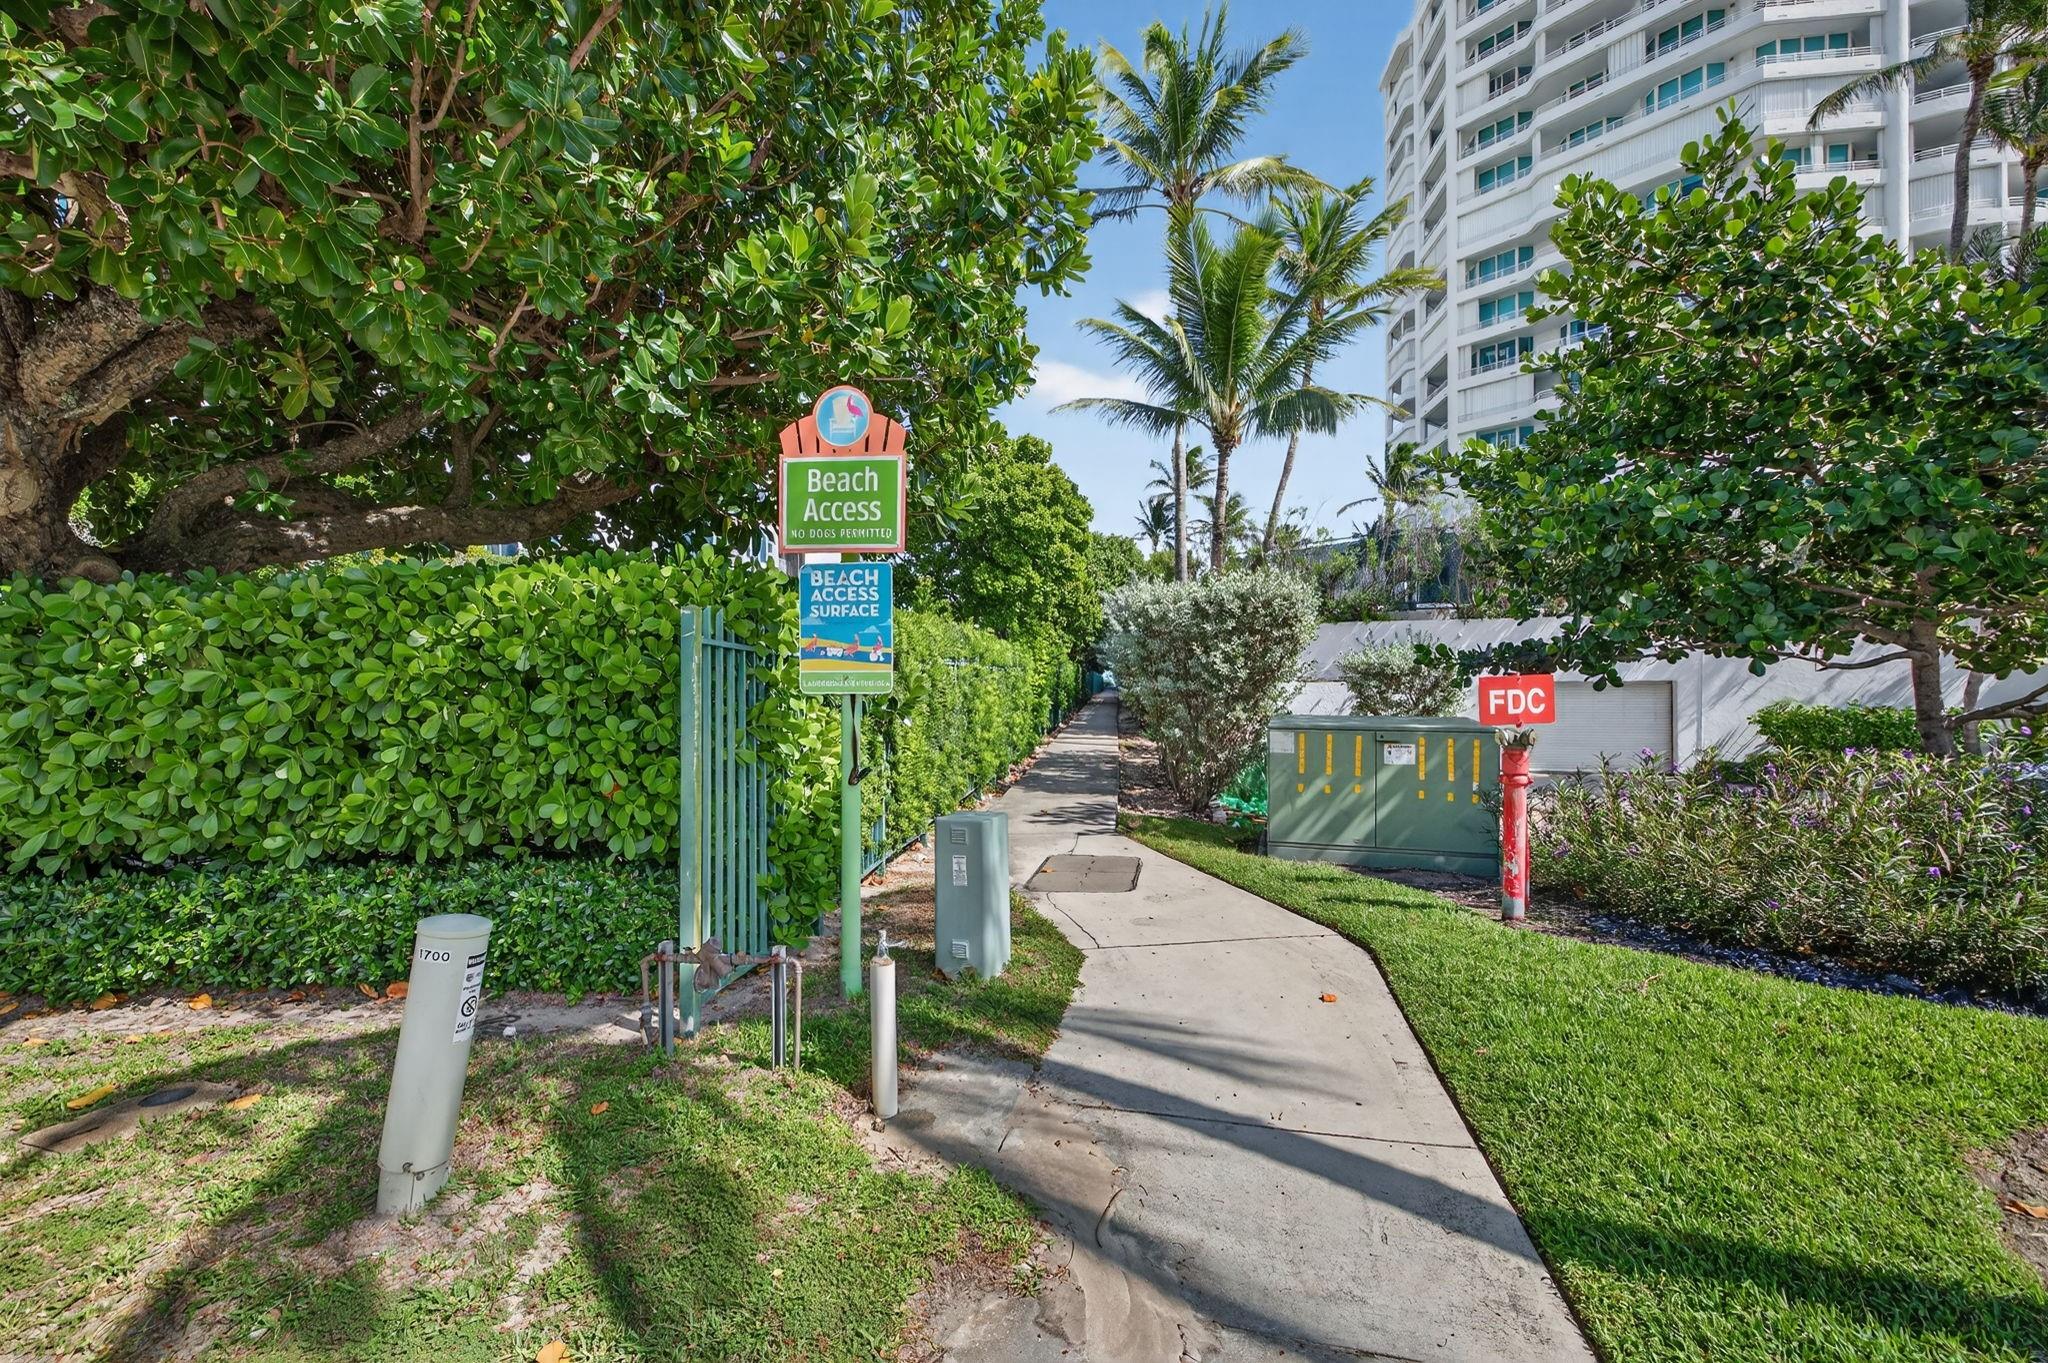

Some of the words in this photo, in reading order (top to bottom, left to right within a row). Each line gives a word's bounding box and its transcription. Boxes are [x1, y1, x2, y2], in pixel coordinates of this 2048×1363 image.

[808, 466, 878, 492] Beach
[803, 498, 881, 521] Access
[791, 529, 805, 539] NO
[809, 529, 836, 538] DOGS
[840, 528, 892, 538] PERMITTED
[811, 569, 879, 586] BEACH
[811, 587, 879, 602] ACCESS
[810, 604, 880, 617] SURFACE
[1489, 688, 1546, 715] FDC
[419, 948, 450, 962] 1700
